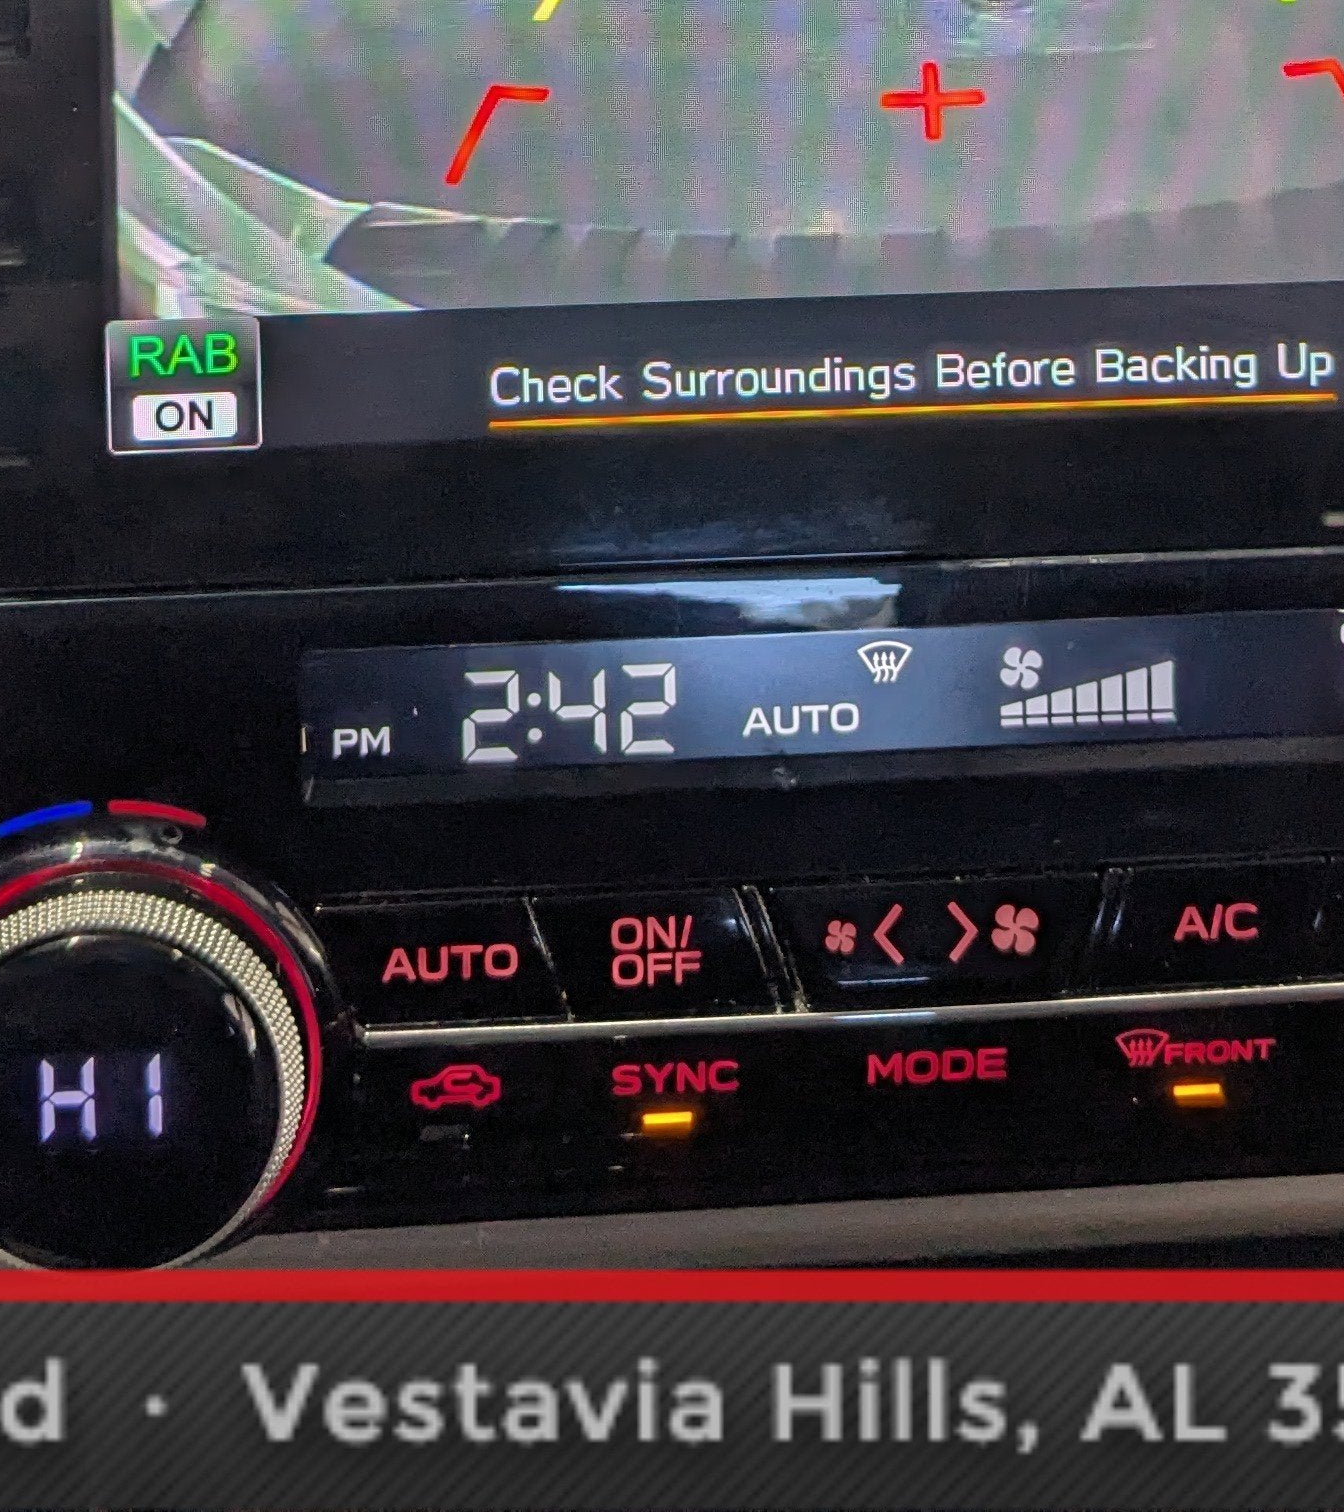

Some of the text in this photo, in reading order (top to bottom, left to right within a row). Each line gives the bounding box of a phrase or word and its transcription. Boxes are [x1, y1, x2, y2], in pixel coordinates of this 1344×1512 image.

[128, 333, 240, 378] RAB
[489, 341, 1337, 407] Check Surroundings Before Backing Up
[154, 400, 215, 433] ON
[462, 662, 677, 763] 2:42
[742, 702, 860, 738] AUTO
[333, 726, 391, 759] PM
[610, 915, 694, 951] ON/
[1173, 902, 1259, 942] A/C
[382, 943, 519, 984] AUTO
[610, 950, 702, 987] OFF
[867, 1046, 1009, 1086] MODE
[1164, 1037, 1277, 1066] FRONT
[611, 1059, 741, 1096] SYNC
